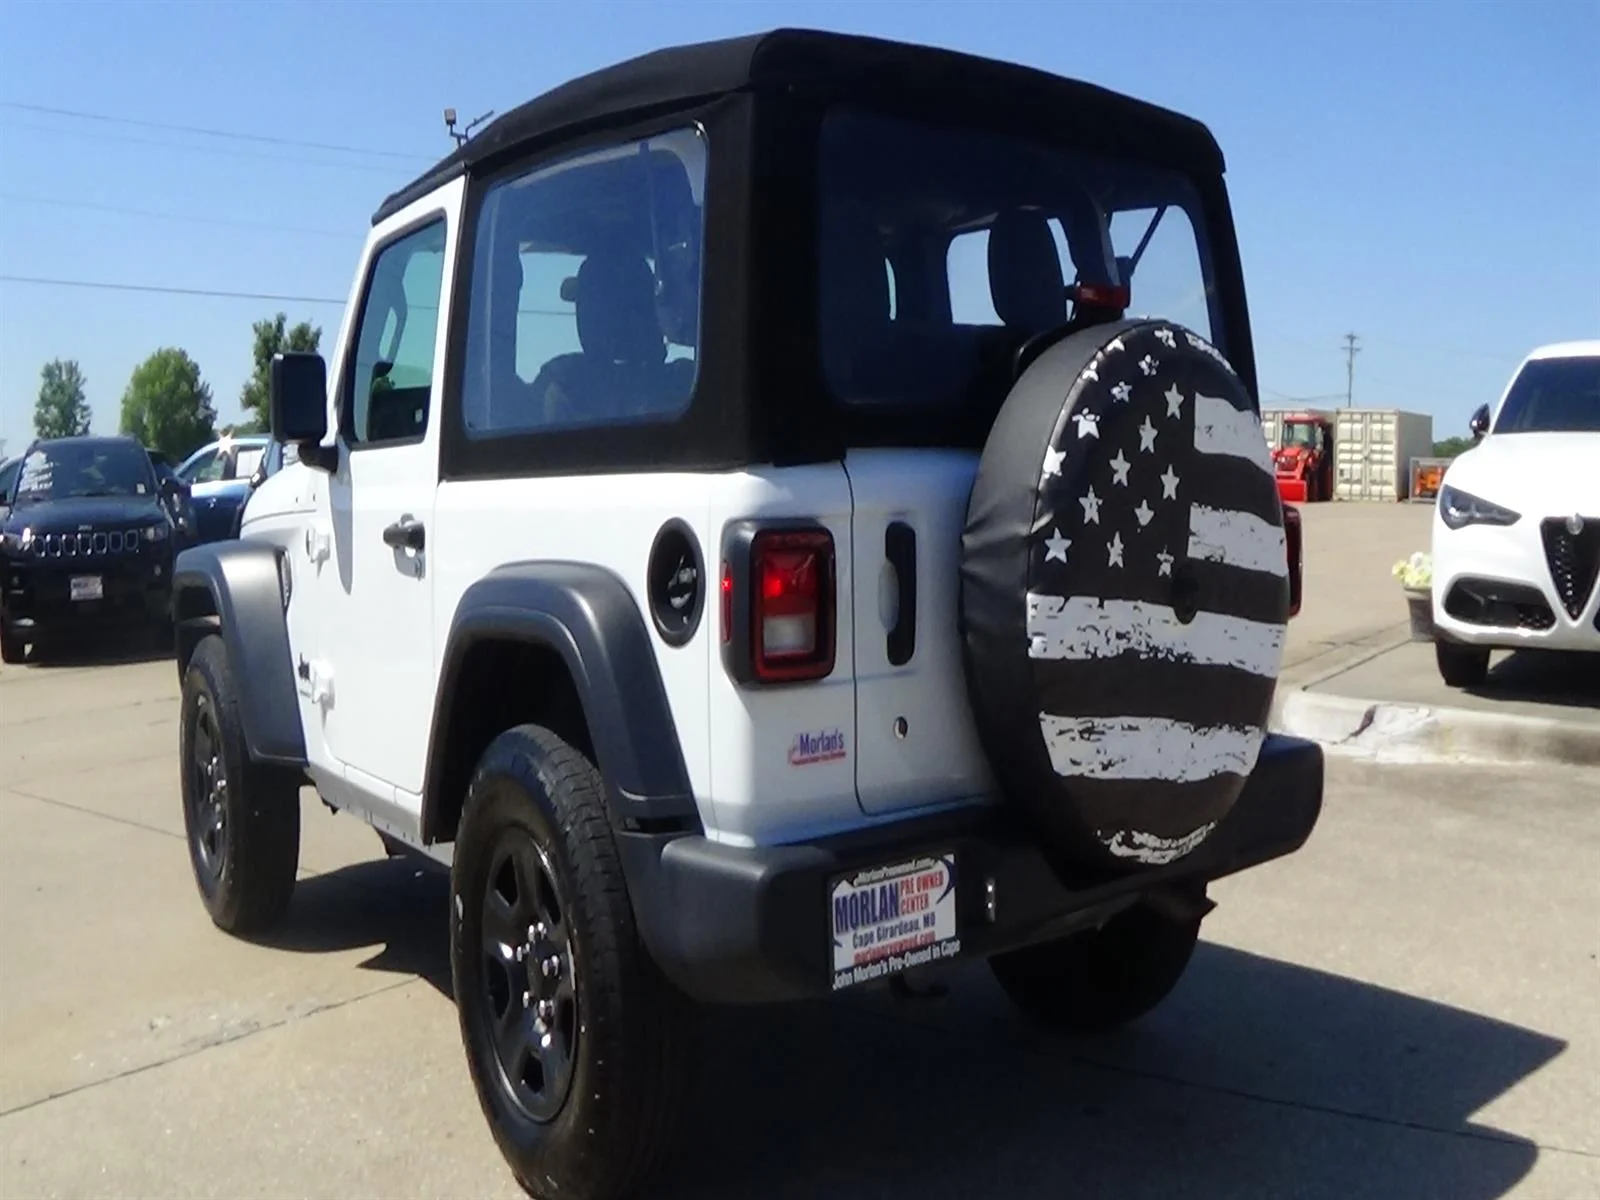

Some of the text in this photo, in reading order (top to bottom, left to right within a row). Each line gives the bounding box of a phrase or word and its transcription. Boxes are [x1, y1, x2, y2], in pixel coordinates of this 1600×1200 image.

[835, 882, 899, 934] MORLAN
[901, 893, 929, 915] CENTER
[852, 931, 874, 949] Cape
[923, 911, 936, 929] MO
[832, 971, 854, 991] John
